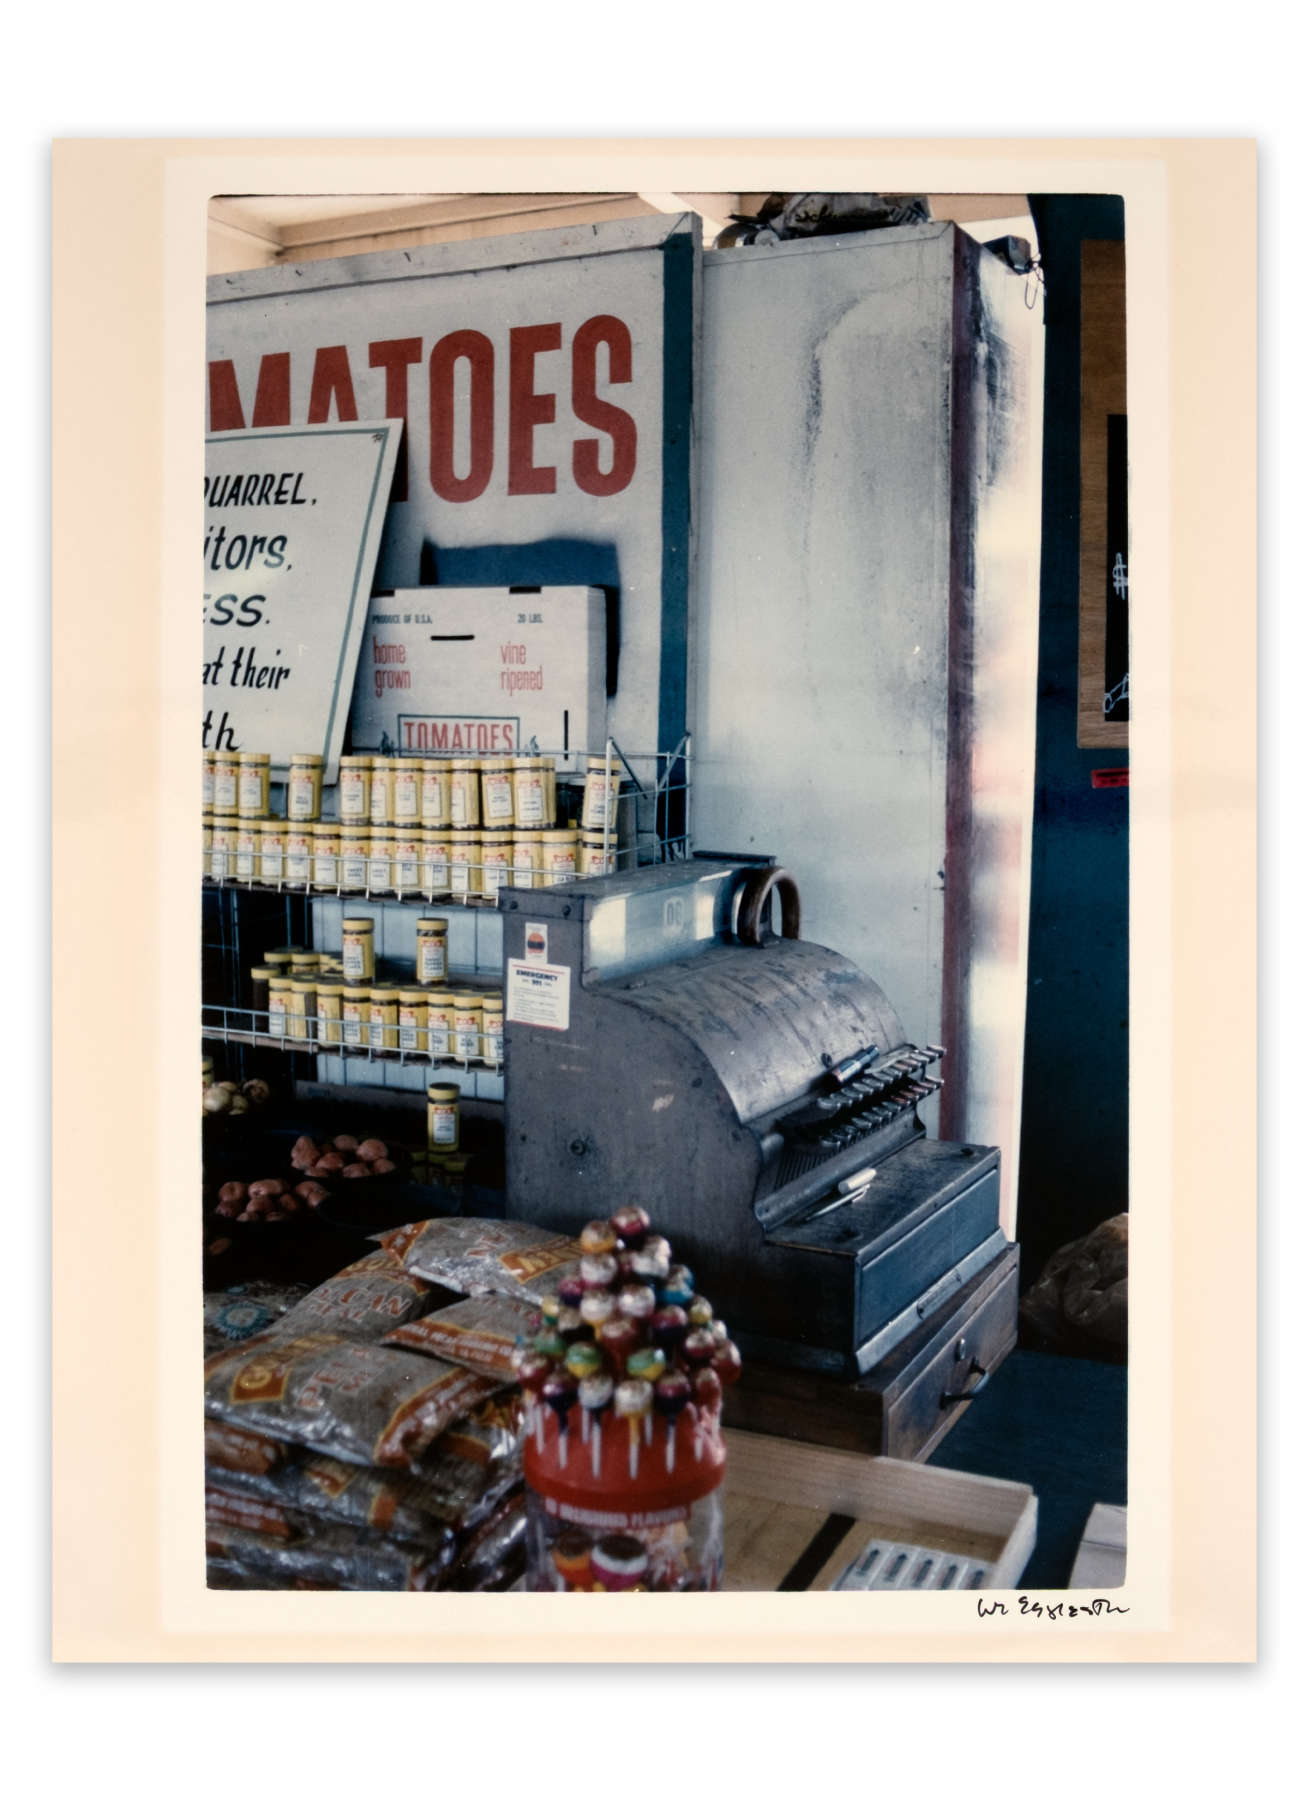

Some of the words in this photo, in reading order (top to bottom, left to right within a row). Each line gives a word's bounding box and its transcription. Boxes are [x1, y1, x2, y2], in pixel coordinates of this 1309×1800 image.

[204, 472, 317, 507] UARREL,
[403, 614, 412, 624] OF
[372, 635, 406, 665] home
[500, 640, 527, 665] vine
[230, 646, 290, 690] their
[375, 669, 411, 698] grown
[500, 664, 544, 697] ripened
[403, 721, 514, 756] TOMATOES
